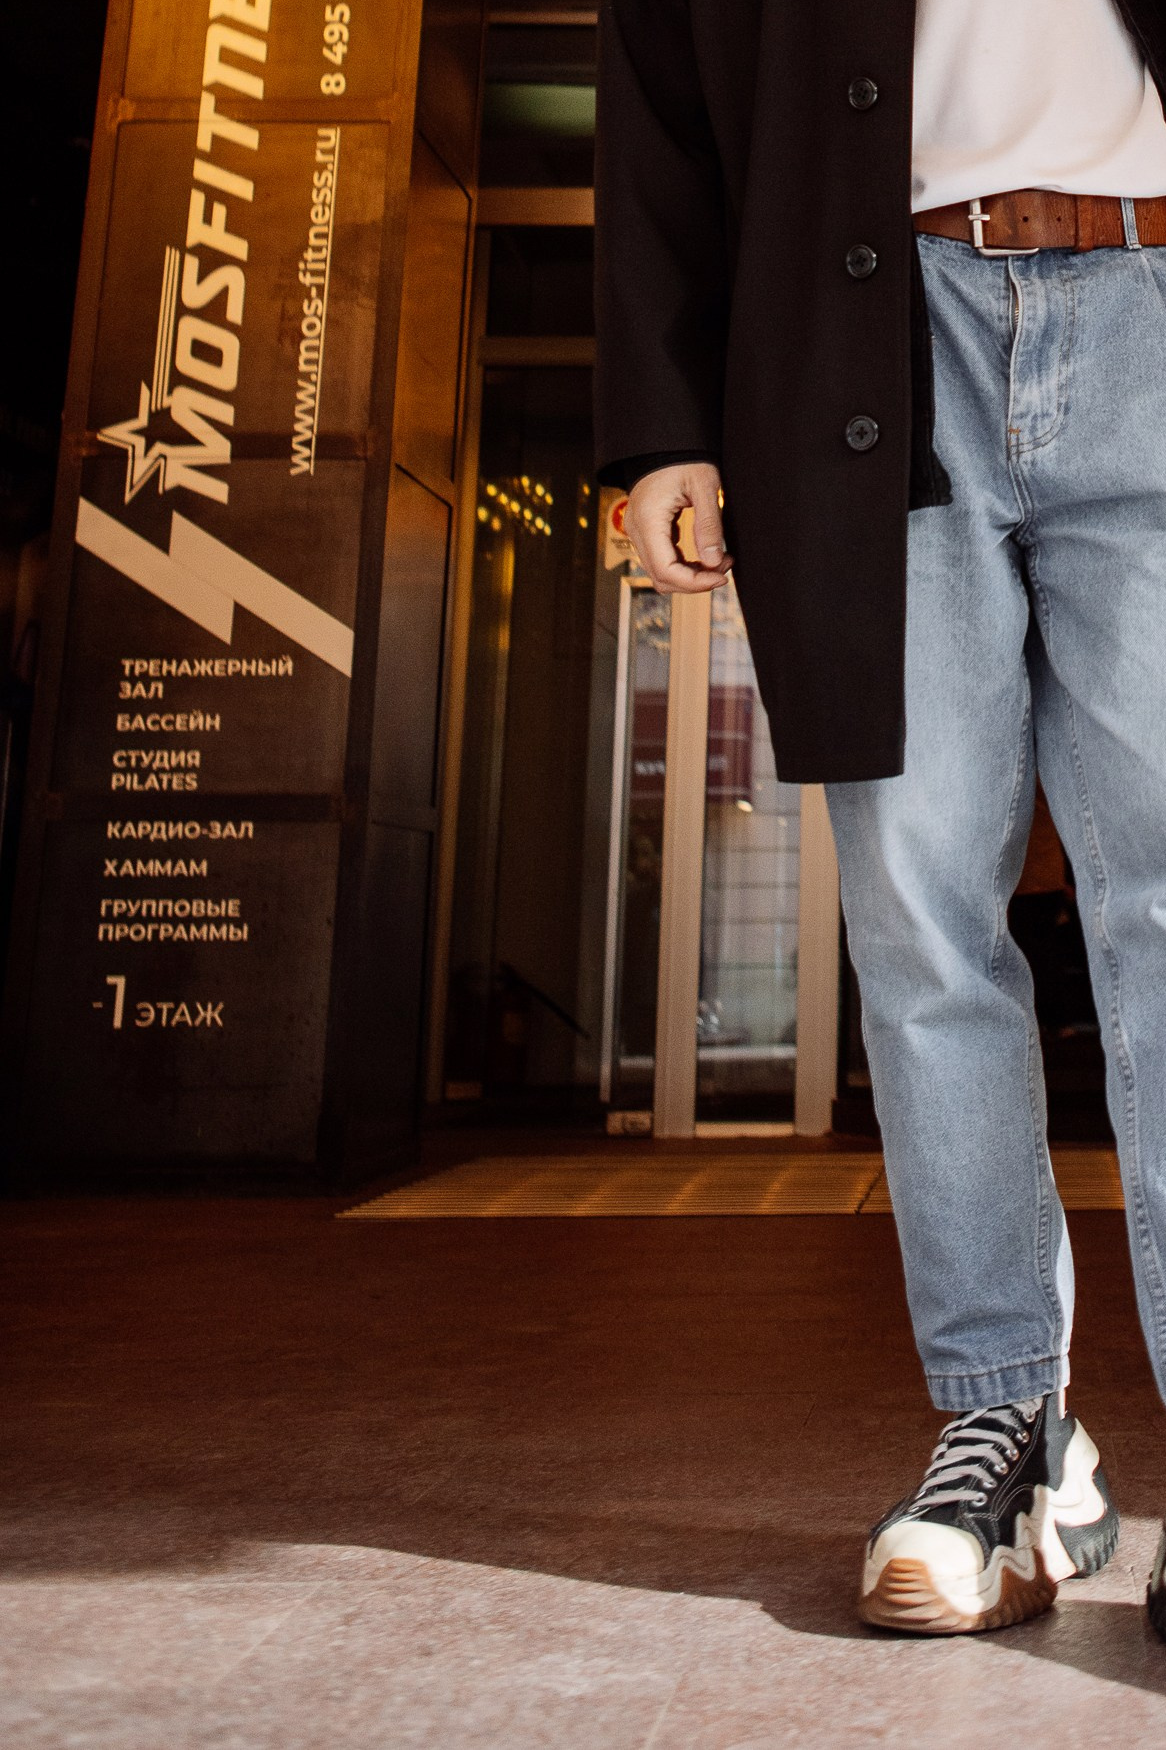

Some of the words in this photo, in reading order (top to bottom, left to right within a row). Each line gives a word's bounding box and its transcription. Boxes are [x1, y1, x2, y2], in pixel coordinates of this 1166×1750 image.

[322, 3, 351, 66] 495
[320, 73, 346, 96] 8
[290, 126, 341, 476] www.mos-fitness.ru
[121, 655, 294, 677] ТРЕНАЖЕРНЫЙ
[118, 680, 164, 699] ЗАЛ
[116, 709, 221, 732] БАССЕЙН
[112, 749, 201, 770] СТУДИЯ
[111, 772, 198, 791] PILATES
[106, 820, 254, 842] КАРДИО-ЗАЛ
[103, 858, 208, 878] ХАММАМ
[100, 899, 241, 918] ГРУППОВЫЕ
[98, 923, 249, 942] ПРОГРАММЫ
[92, 975, 127, 1029] -1
[134, 1001, 224, 1028] ЭТАЖ
